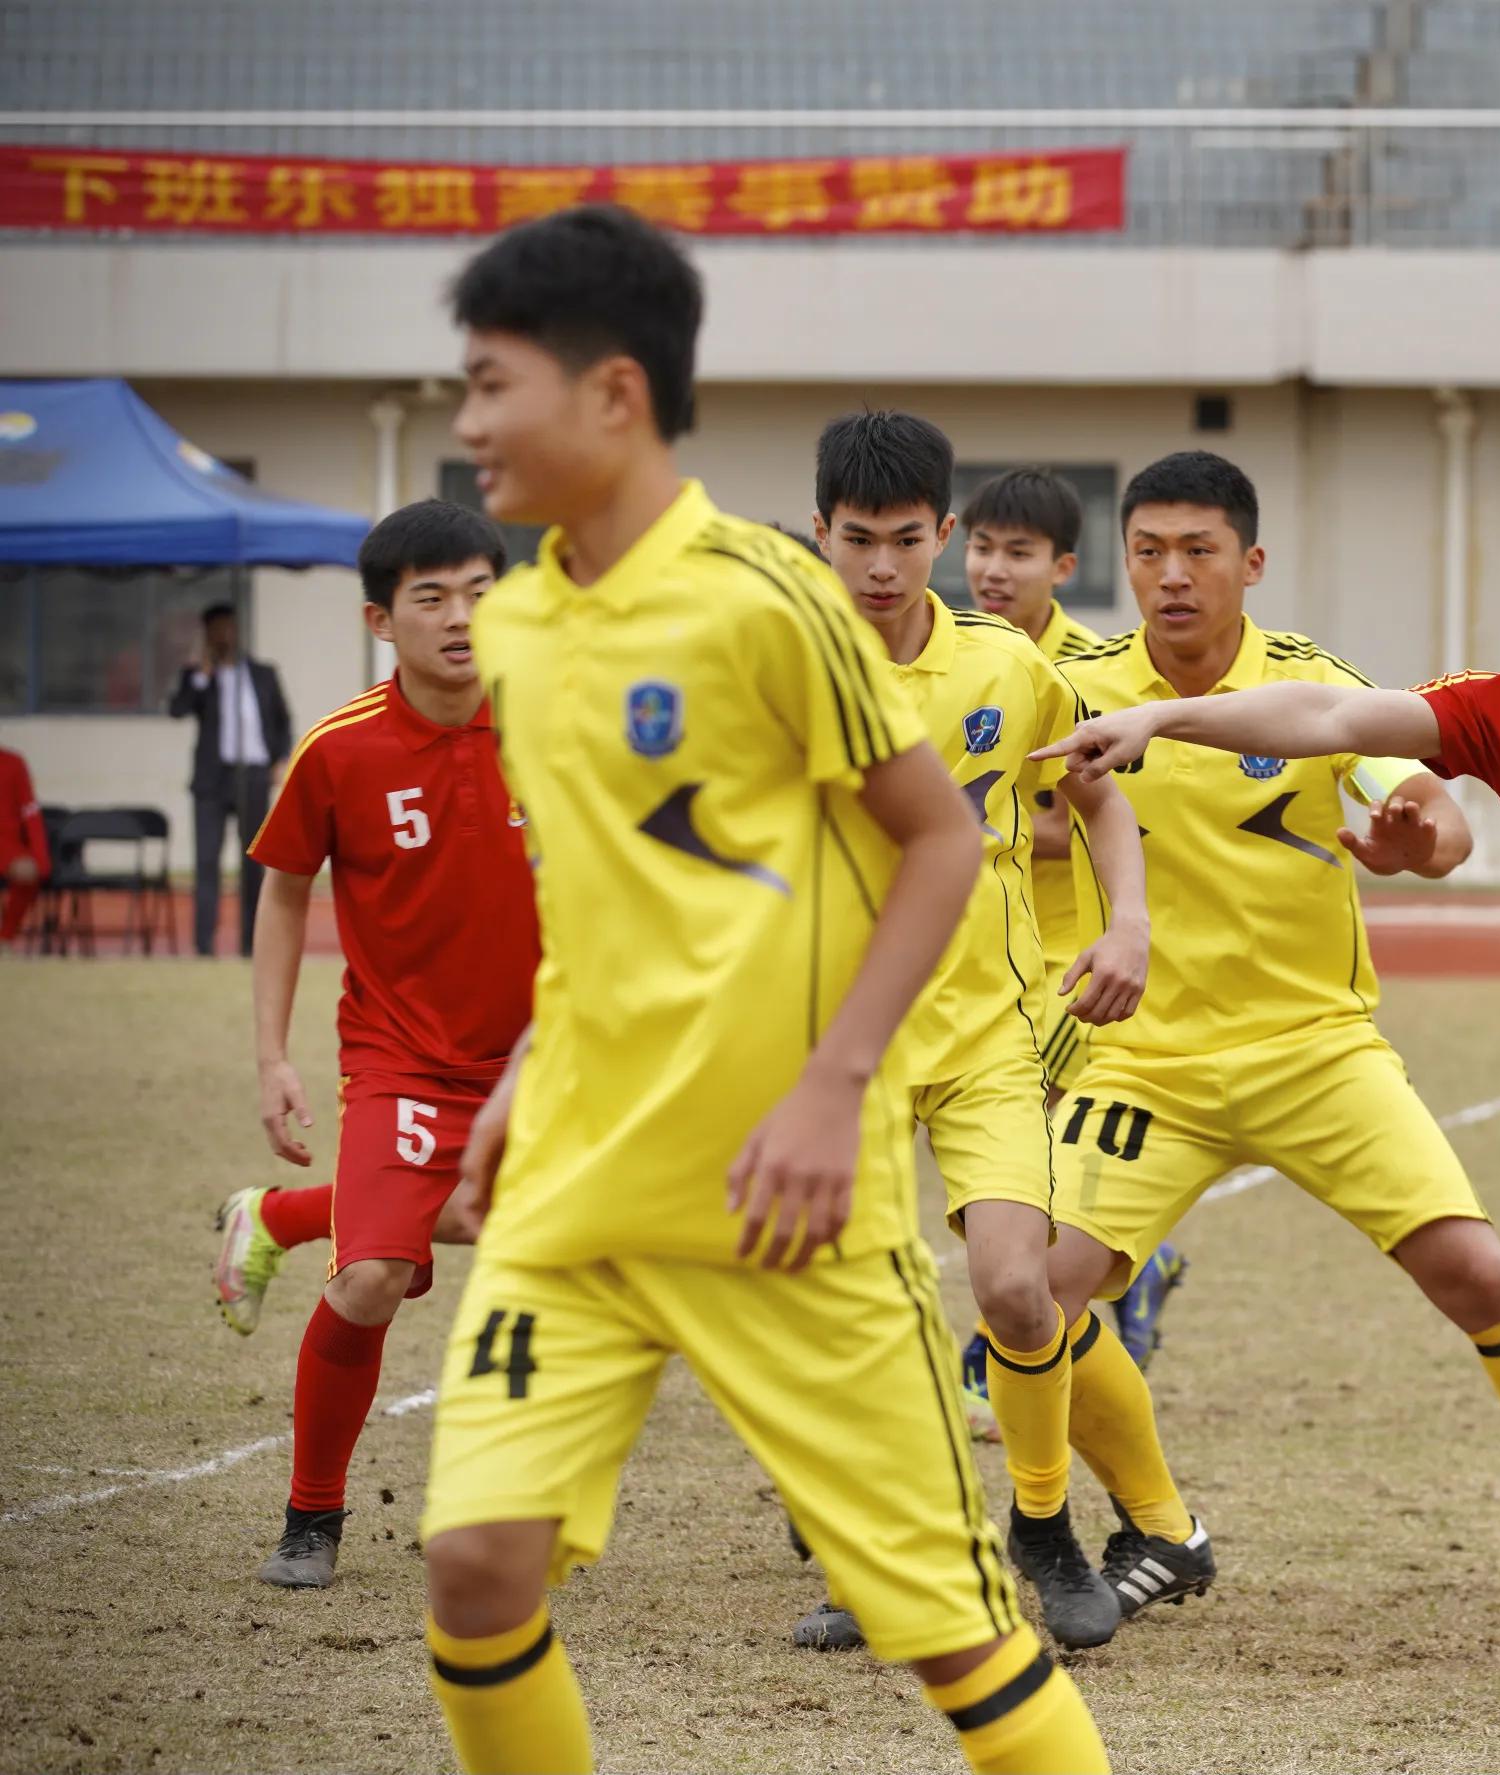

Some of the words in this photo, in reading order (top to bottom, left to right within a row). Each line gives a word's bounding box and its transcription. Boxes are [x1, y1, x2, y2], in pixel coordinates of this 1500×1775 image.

[386, 787, 431, 849] 5
[397, 1097, 437, 1166] 5
[1061, 1096, 1154, 1161] 10
[467, 1309, 537, 1400] 4
